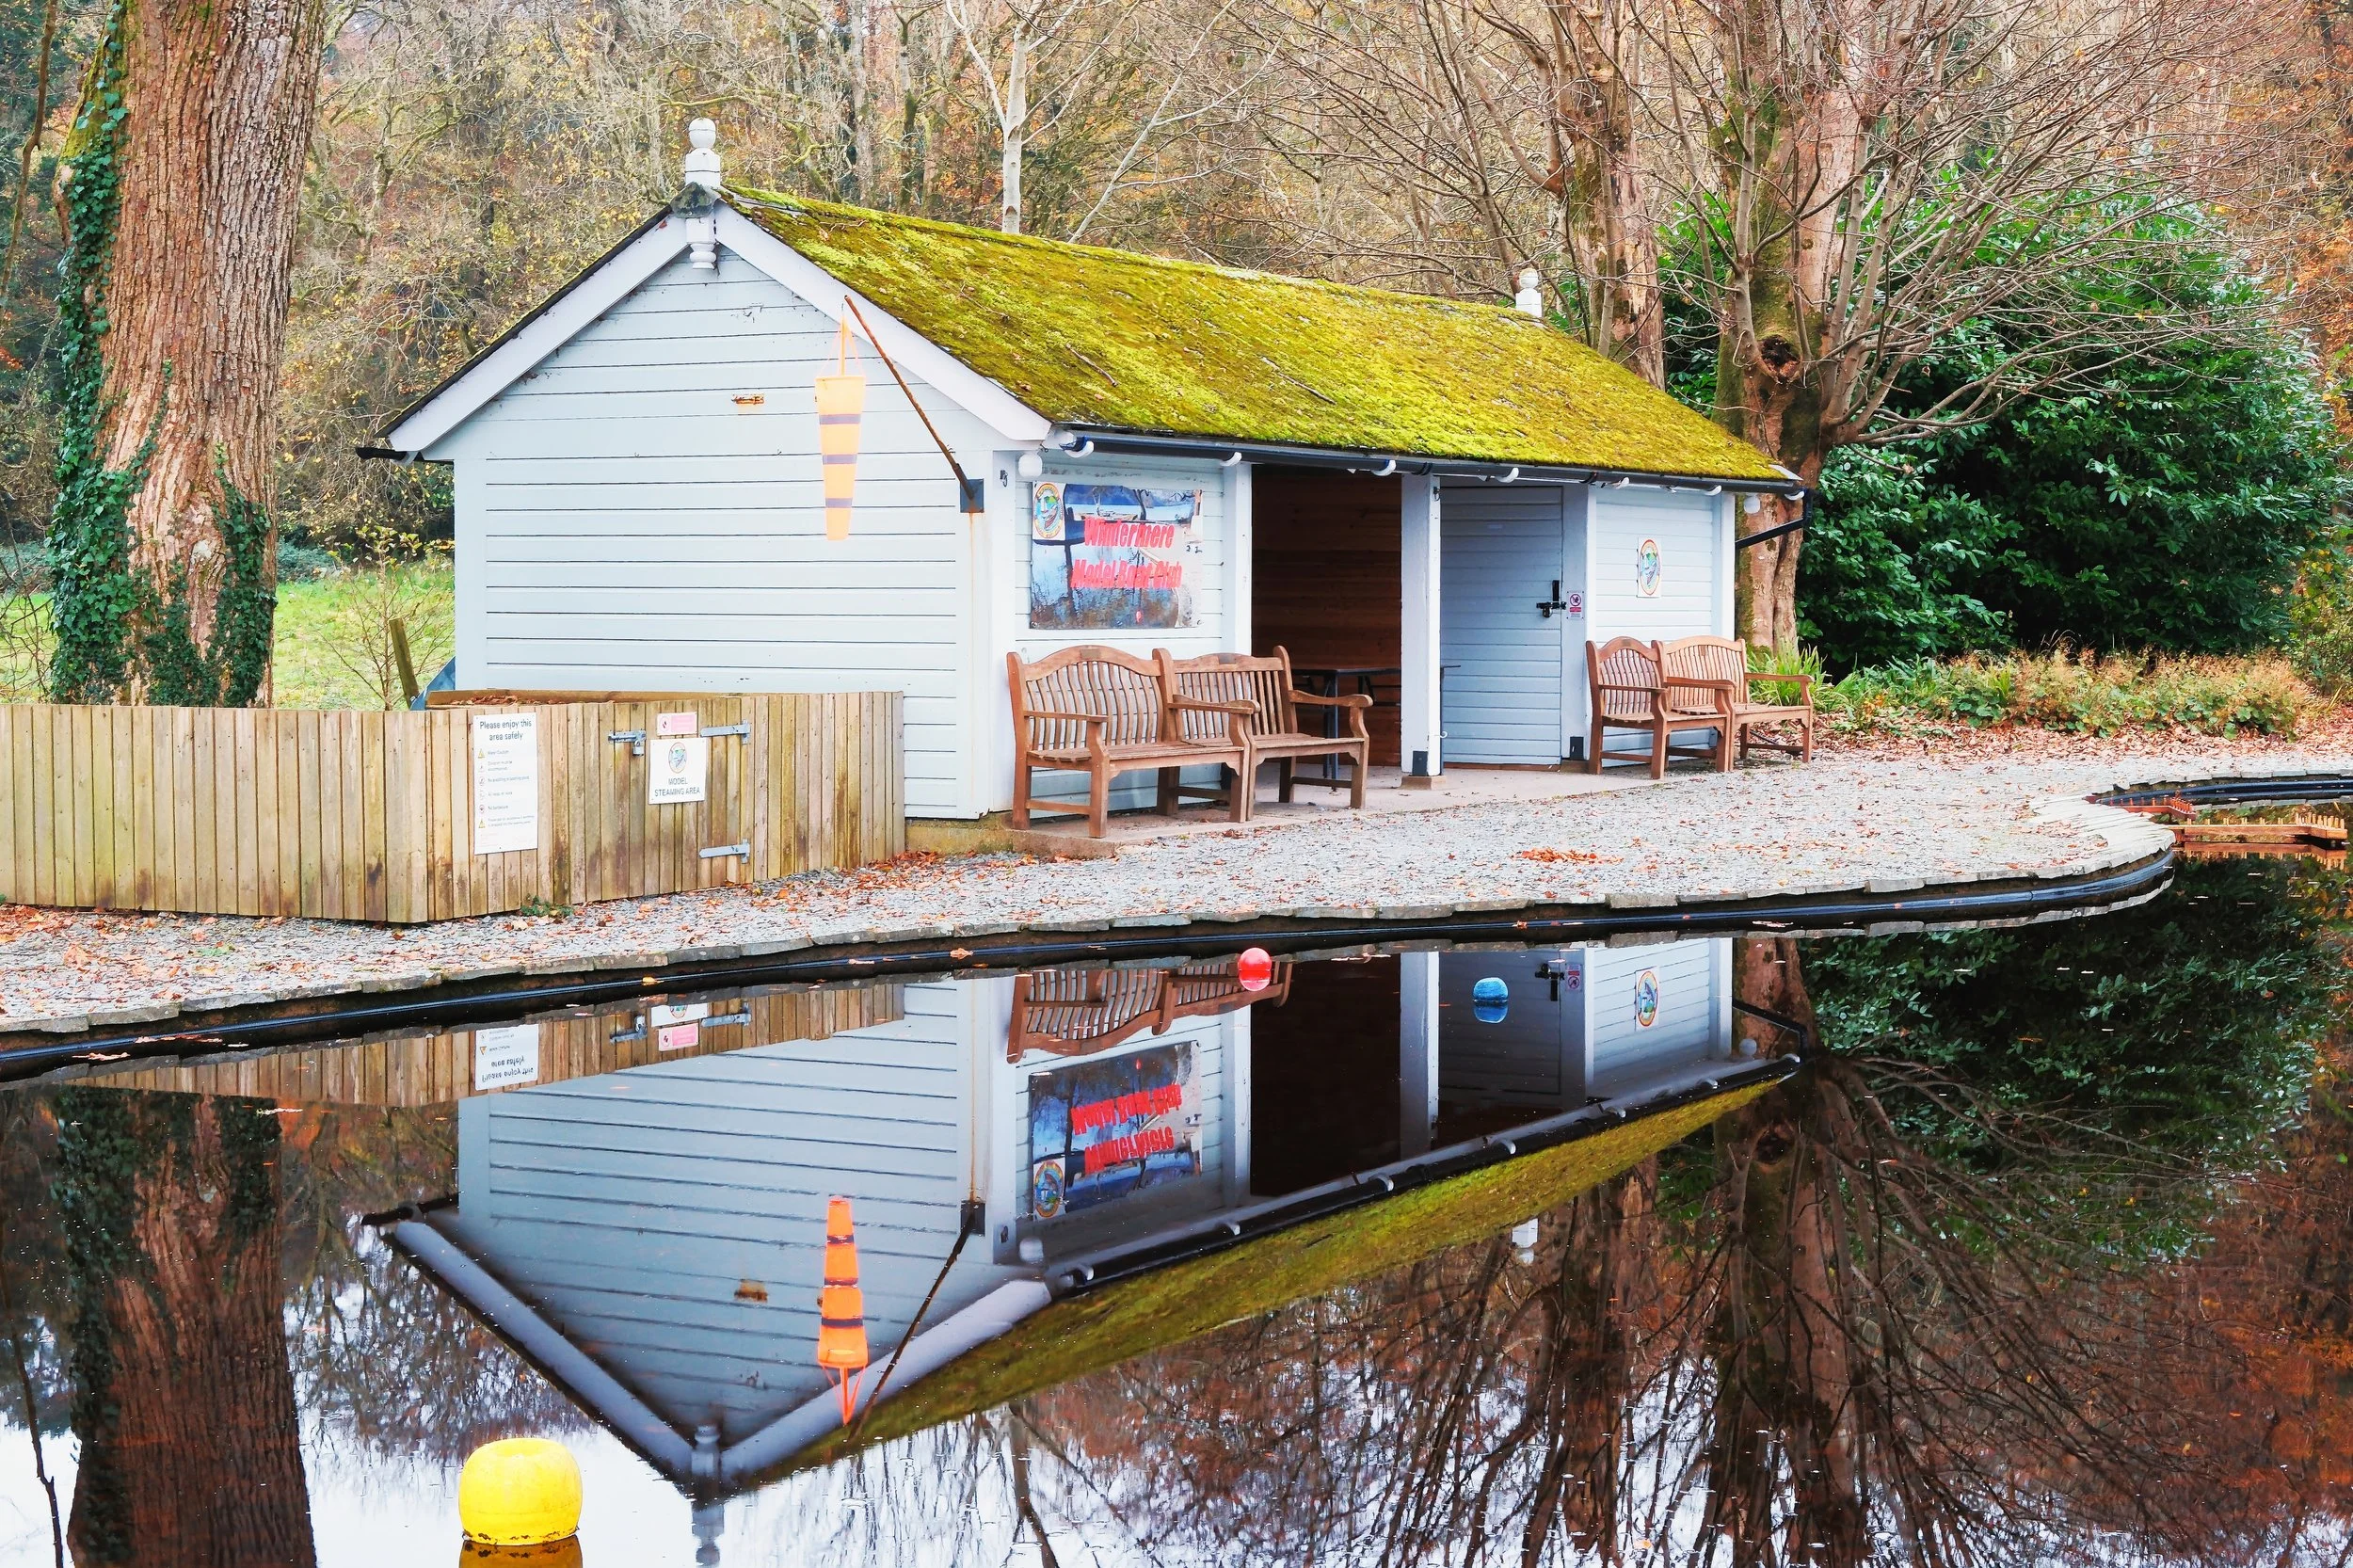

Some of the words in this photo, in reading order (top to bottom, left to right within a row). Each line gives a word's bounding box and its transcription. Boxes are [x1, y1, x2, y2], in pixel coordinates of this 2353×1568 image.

[1084, 516, 1176, 548] Windermere
[1070, 559, 1116, 588] Model
[1117, 560, 1153, 588] Boat
[1153, 560, 1182, 589] Club
[480, 720, 501, 729] Please
[502, 719, 519, 729] enjoy
[520, 718, 532, 728] this
[504, 730, 522, 741] safely
[668, 776, 688, 785] MODEL
[654, 788, 685, 797] STEAMING
